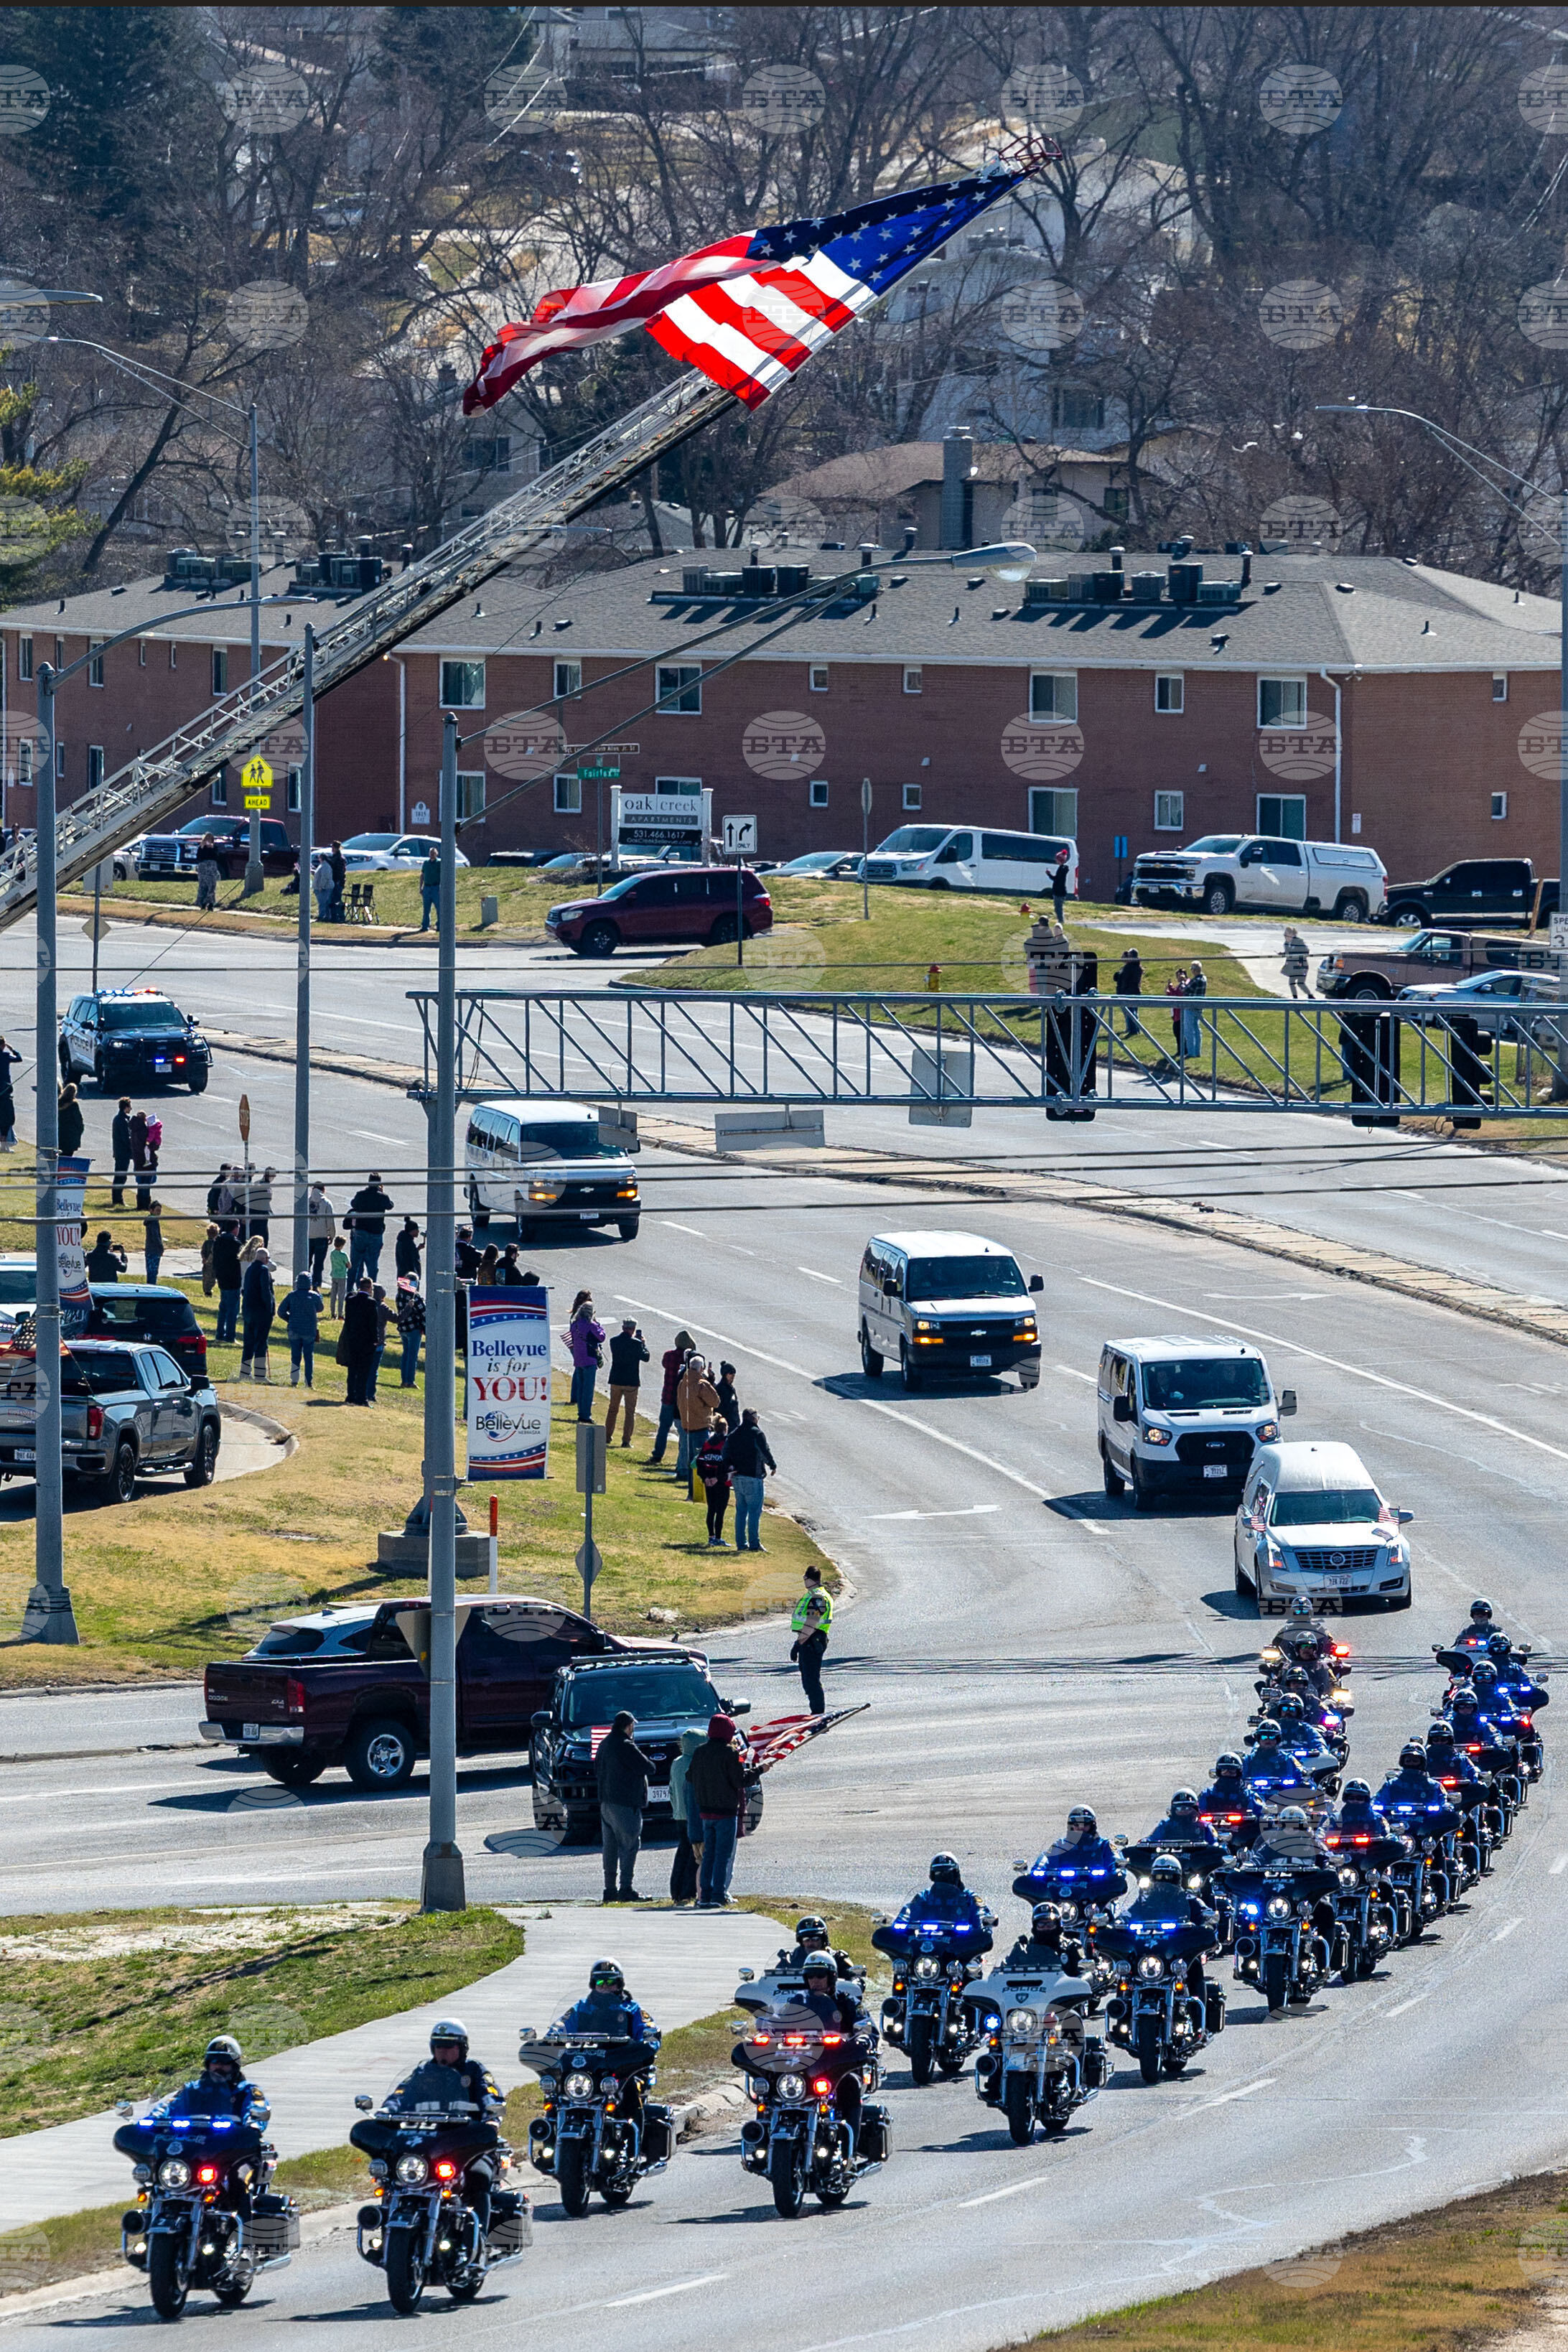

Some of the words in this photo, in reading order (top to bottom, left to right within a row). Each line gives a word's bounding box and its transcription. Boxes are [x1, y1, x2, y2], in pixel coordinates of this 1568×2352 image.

[625, 796, 653, 811] oak
[660, 799, 697, 811] creek
[630, 816, 693, 824] APARTMENTS
[633, 829, 686, 839] 531.466.1617
[1553, 934, 1565, 947] 3
[56, 1226, 81, 1246] YOU!
[471, 1340, 547, 1356] Bellevue
[487, 1357, 500, 1373] is
[503, 1357, 531, 1376] for
[472, 1376, 547, 1401] YOU!
[558, 2049, 607, 2058] POLICE
[154, 2134, 207, 2145] POLICE
